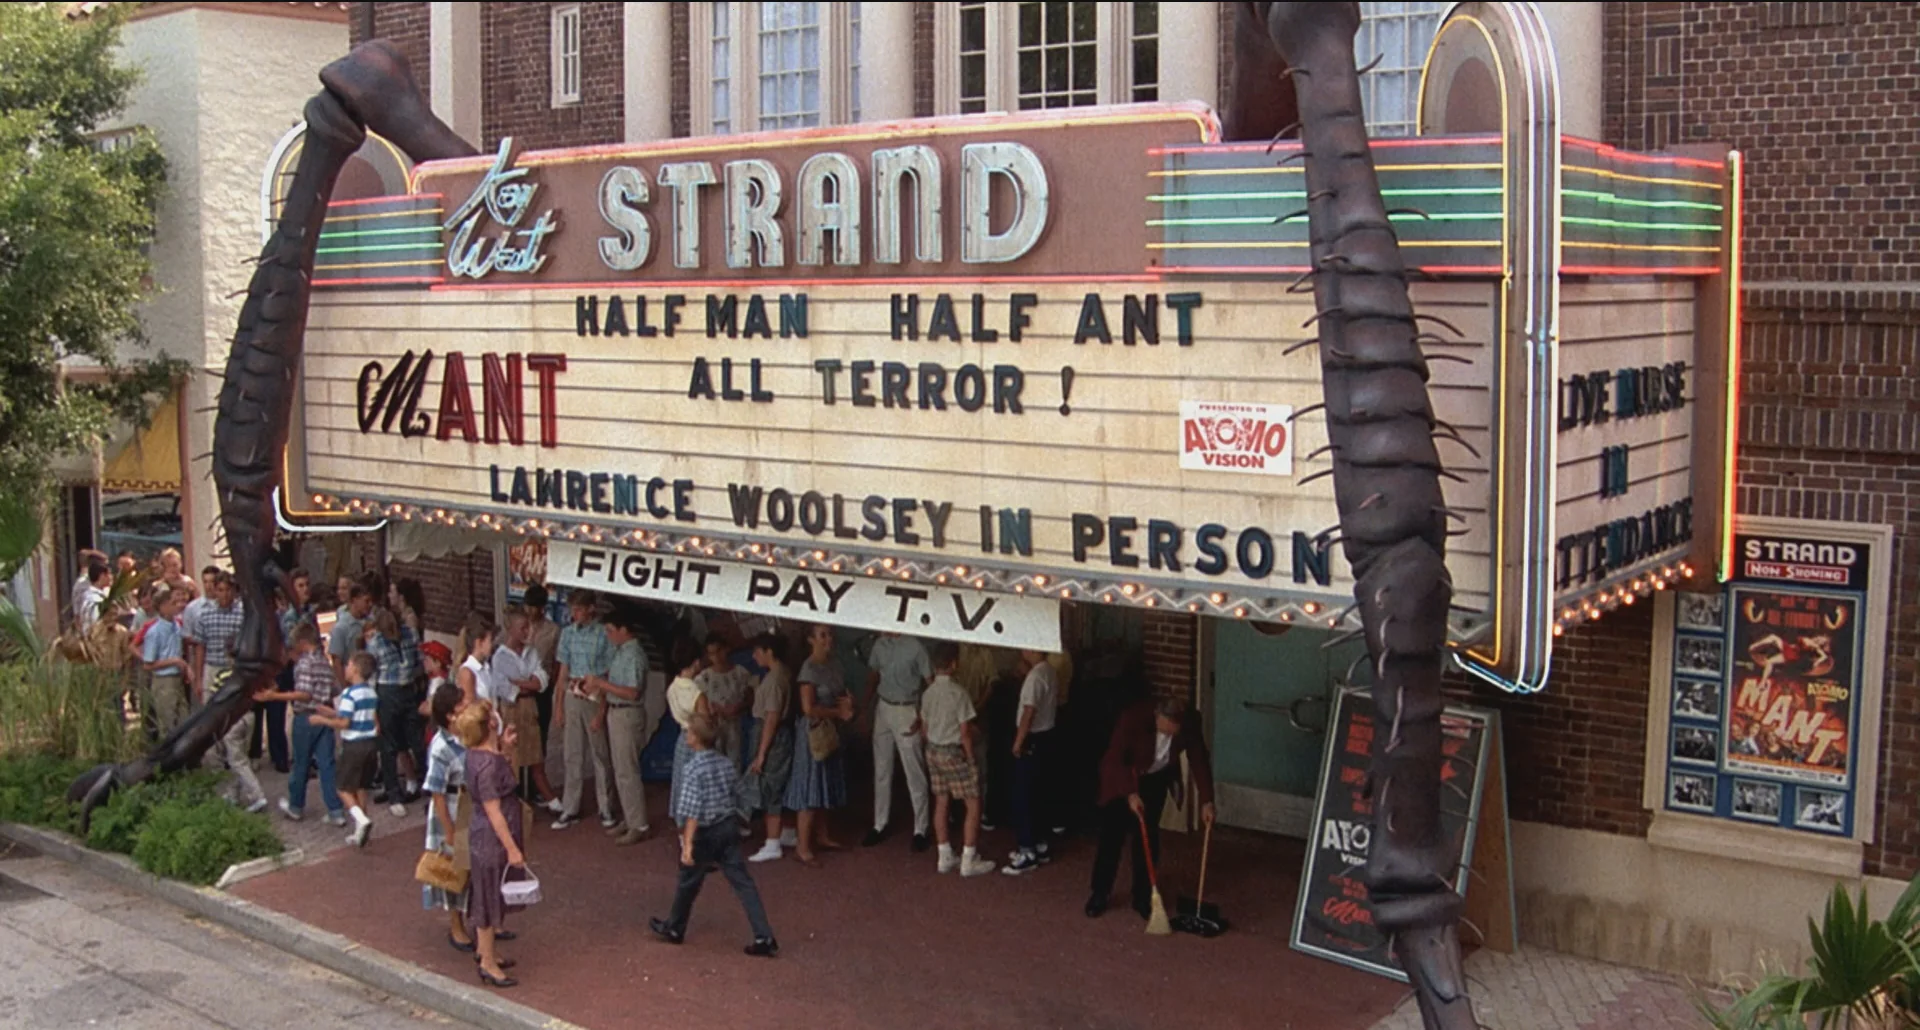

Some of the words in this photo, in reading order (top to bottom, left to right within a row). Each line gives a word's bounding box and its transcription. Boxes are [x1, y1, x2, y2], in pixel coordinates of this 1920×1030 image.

[444, 137, 538, 226] Key
[598, 142, 1049, 271] STRAND
[448, 208, 556, 279] West
[576, 294, 686, 338] HALF
[706, 293, 808, 338] MAN
[890, 293, 1038, 343] HALF
[1074, 293, 1203, 346] ANT
[357, 348, 567, 448] MANT
[688, 356, 773, 403] ALL
[815, 360, 1024, 414] TERROR
[1059, 366, 1075, 416] !
[1557, 369, 1609, 434] LIVE
[1616, 361, 1685, 420] NURSE
[1184, 418, 1286, 457] ATOMO
[1203, 453, 1265, 468] VISION
[1601, 443, 1629, 498] IN
[490, 465, 695, 522] LAWRENCE
[728, 483, 952, 549] WOOLSEY
[980, 505, 1032, 556] IN
[1072, 513, 1331, 586] PERSON
[1554, 498, 1693, 591] TTENDANCE
[1745, 540, 1856, 565] STRAND
[576, 549, 721, 595] FIGHT
[747, 569, 854, 613] PAY
[1737, 679, 1843, 763] MANT
[1322, 819, 1370, 852] ATO
